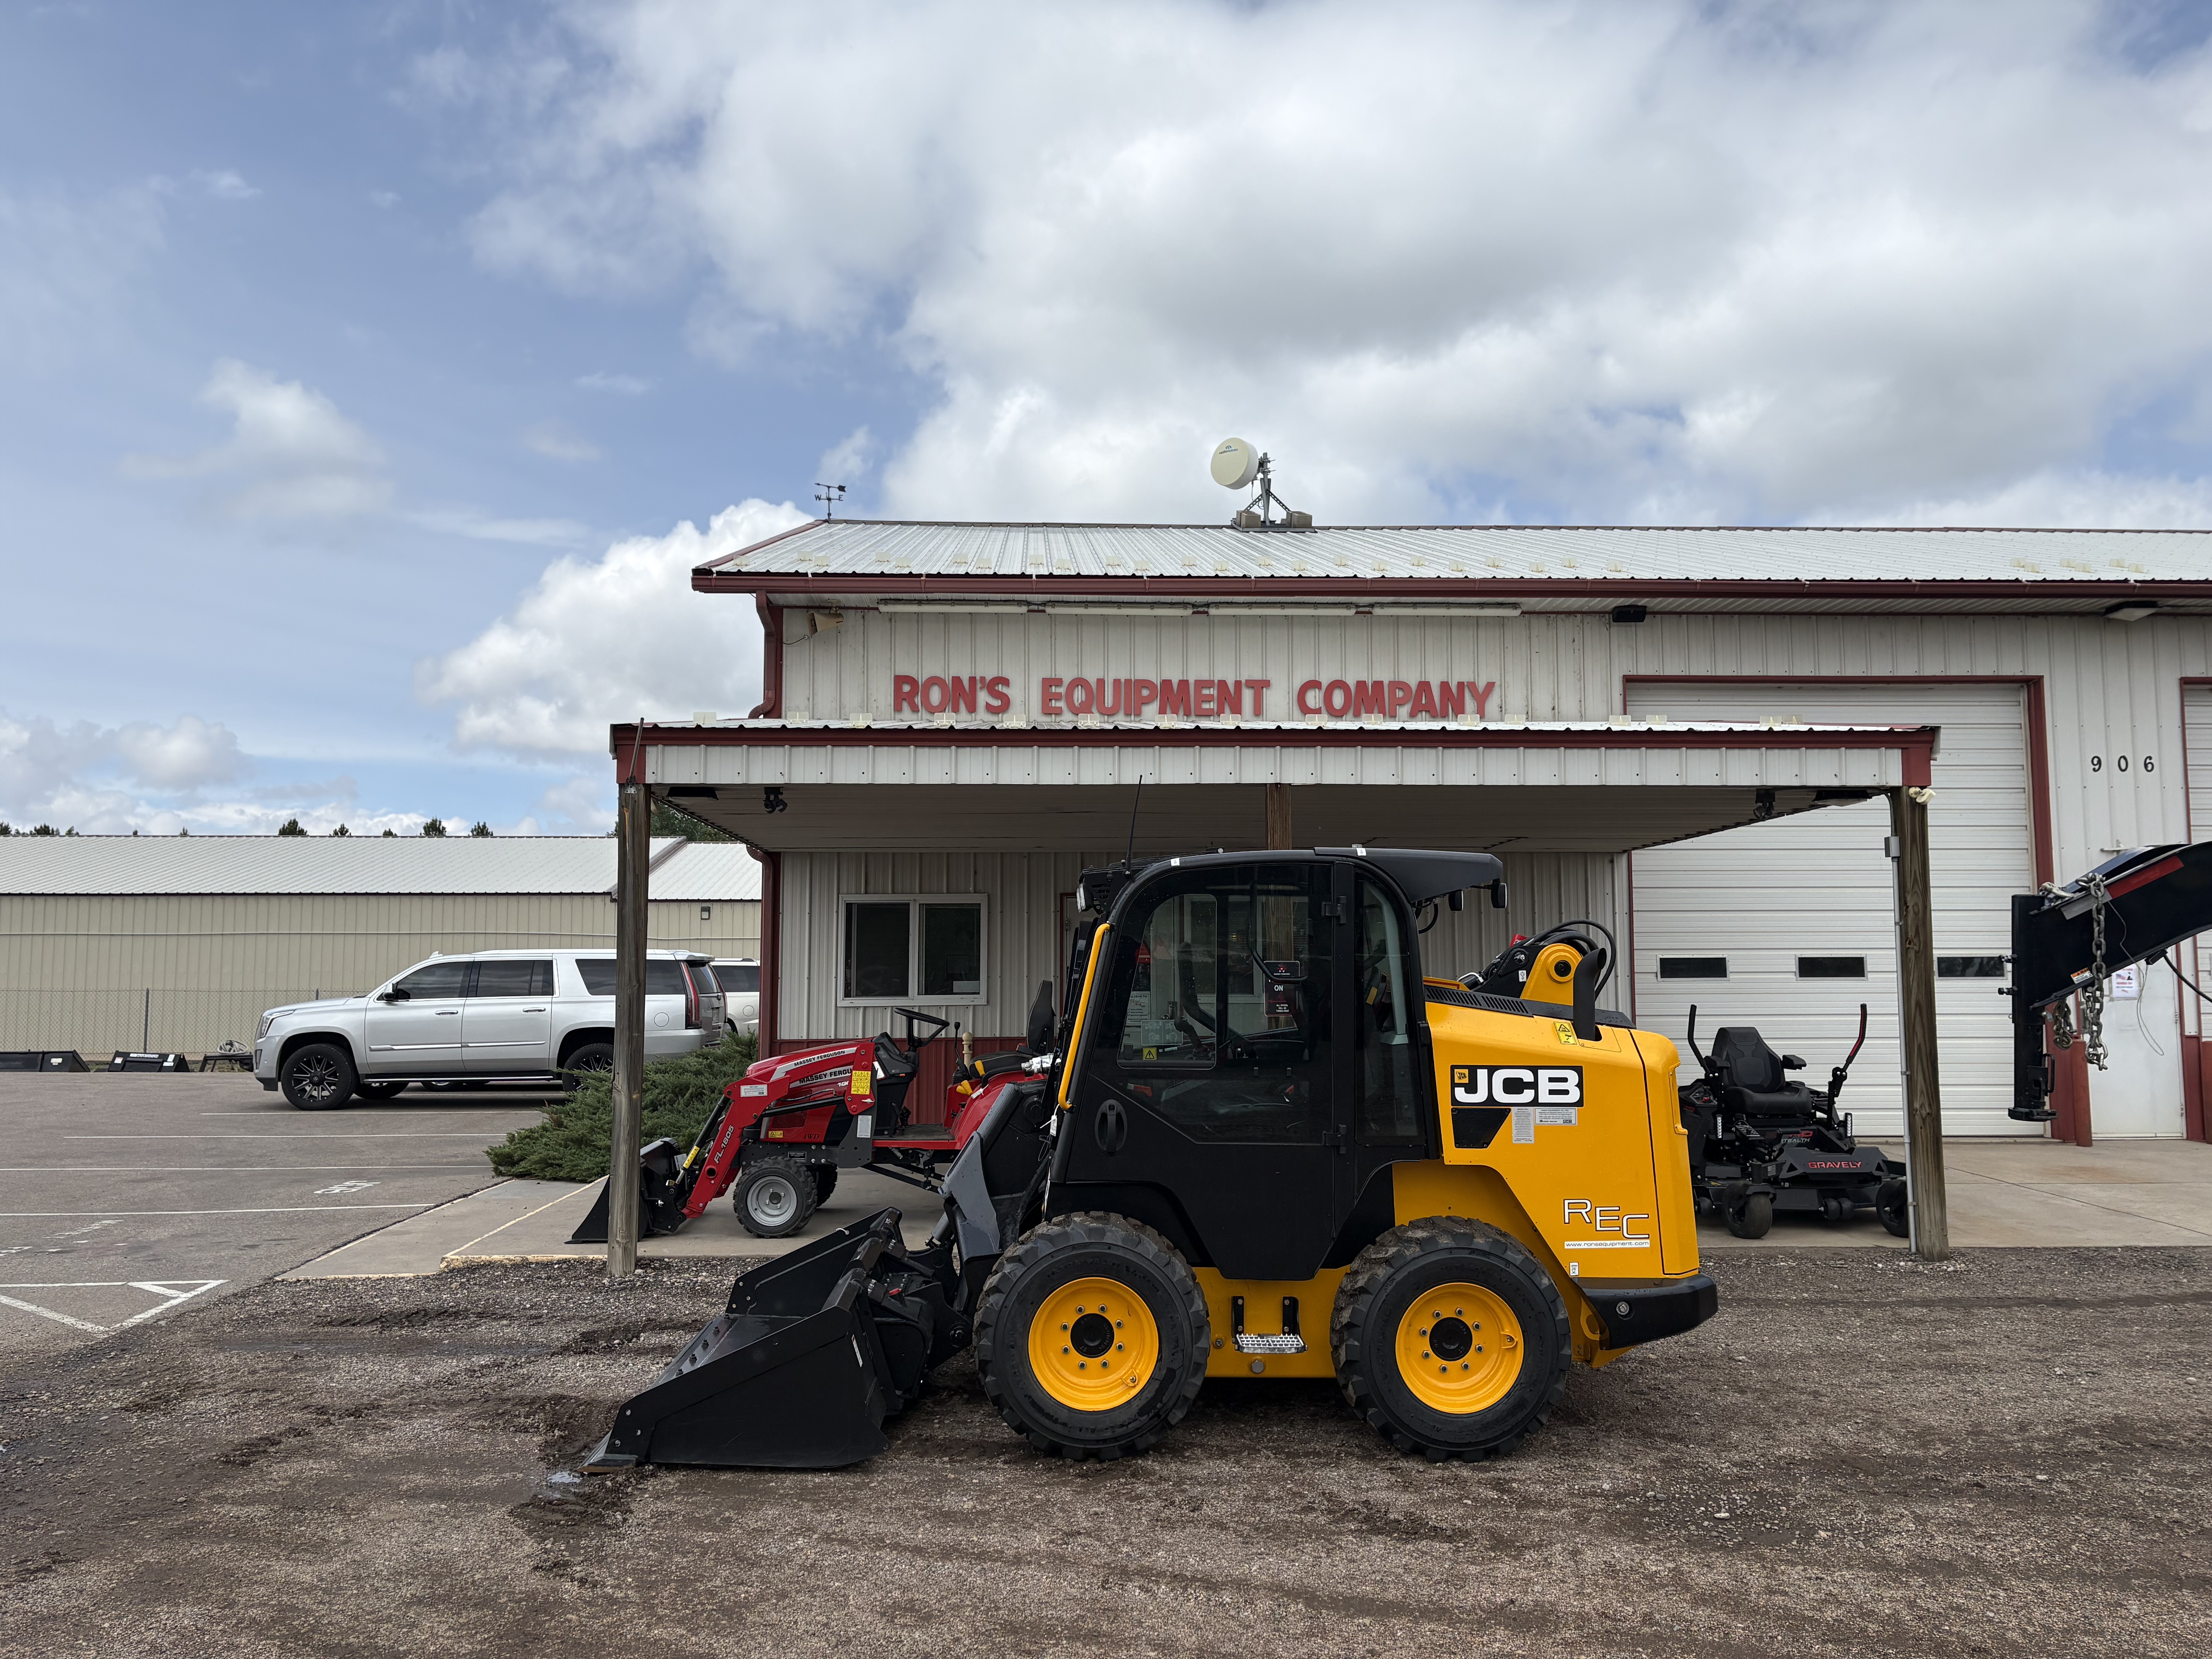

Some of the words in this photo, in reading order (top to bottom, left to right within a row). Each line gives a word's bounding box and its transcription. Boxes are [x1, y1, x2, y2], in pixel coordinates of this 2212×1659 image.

[894, 675, 1010, 713] RON'S
[1042, 677, 1271, 715] EQUIPMENT
[1297, 680, 1496, 717] COMPANY
[794, 1057, 816, 1066] MASSEY
[817, 1050, 845, 1060] FERGUSON
[799, 1073, 828, 1084] MASSEY
[830, 1068, 852, 1078] FERGU
[1455, 1069, 1580, 1103] JCB
[1563, 1199, 1650, 1239] REC
